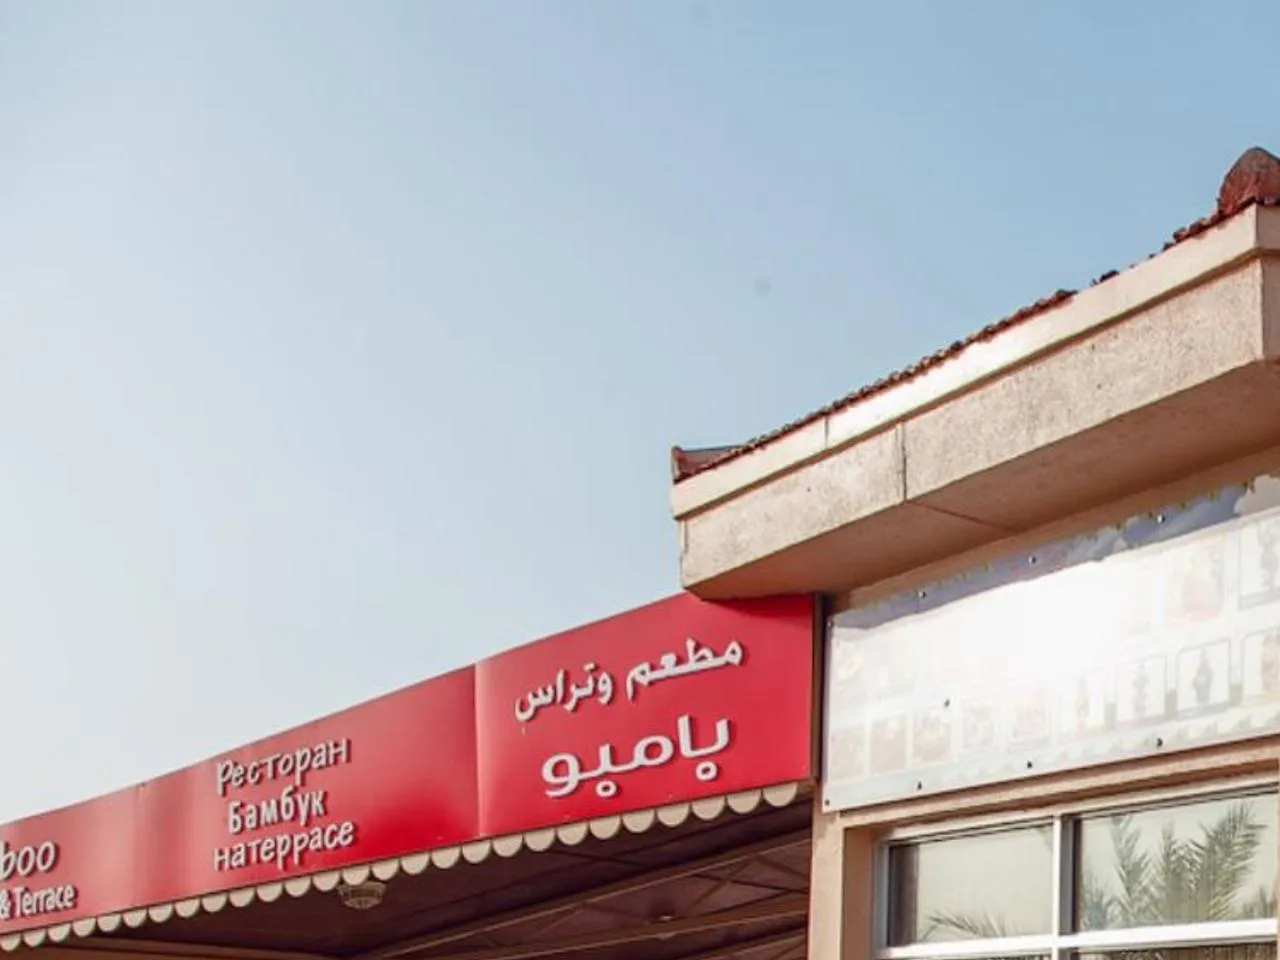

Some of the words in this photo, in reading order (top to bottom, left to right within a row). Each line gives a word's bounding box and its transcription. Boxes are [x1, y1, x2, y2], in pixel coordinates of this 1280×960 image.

[515, 661, 613, 721] وتراس
[626, 638, 743, 701] مطعم
[542, 714, 730, 797] بامبو
[228, 785, 326, 834] Бамбук
[14, 885, 75, 916] Terrace
